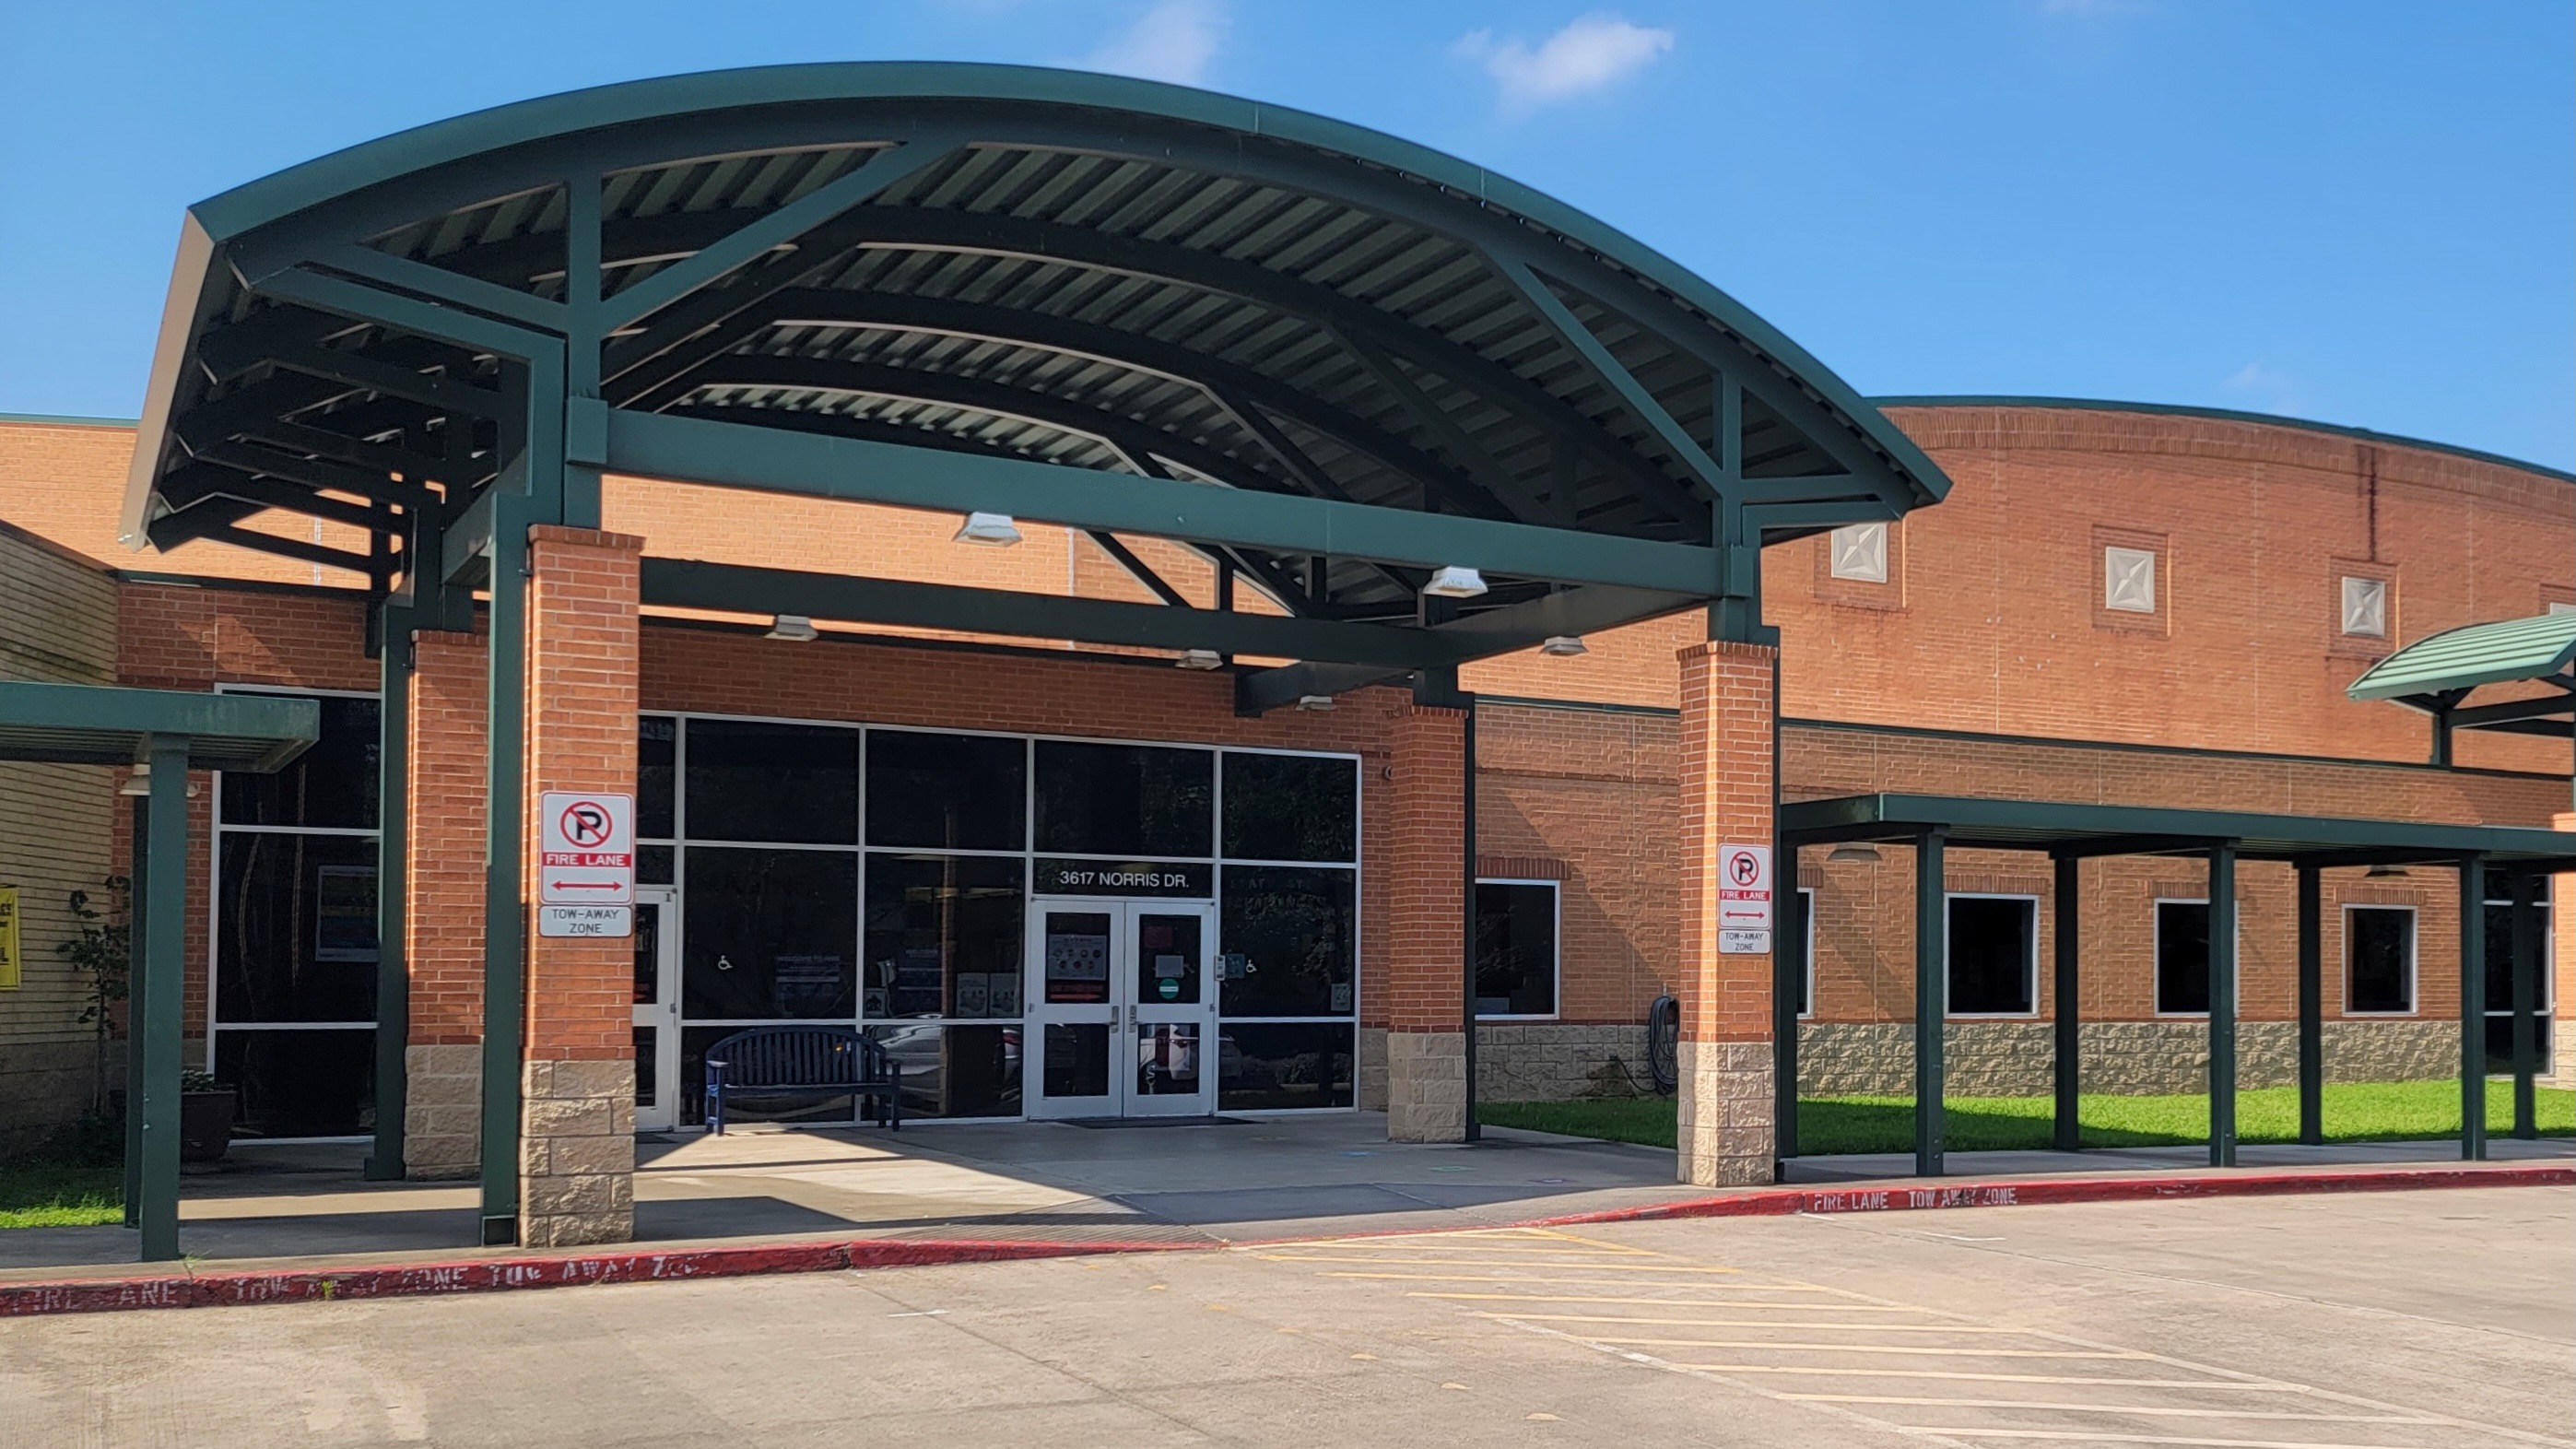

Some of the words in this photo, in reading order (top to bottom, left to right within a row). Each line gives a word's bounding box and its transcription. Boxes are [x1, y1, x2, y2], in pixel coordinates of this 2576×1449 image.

[546, 854, 579, 866] FIRE
[585, 854, 626, 866] LANE
[1060, 870, 1095, 886] 3617
[1099, 872, 1160, 888] NORRIS
[1163, 874, 1190, 889] DR.
[1721, 890, 1740, 900] FIRE
[1743, 890, 1767, 901] LANE
[551, 908, 620, 920] TOW-AWAY
[569, 923, 603, 935] ZONE
[1724, 932, 1764, 941] TOW-AWAY
[1735, 942, 1755, 951] ZONE
[1814, 1193, 1845, 1211] FIRE
[1852, 1191, 1889, 1210] LANE
[1909, 1189, 1935, 1208] TOW
[1983, 1186, 2018, 1206] ZONE
